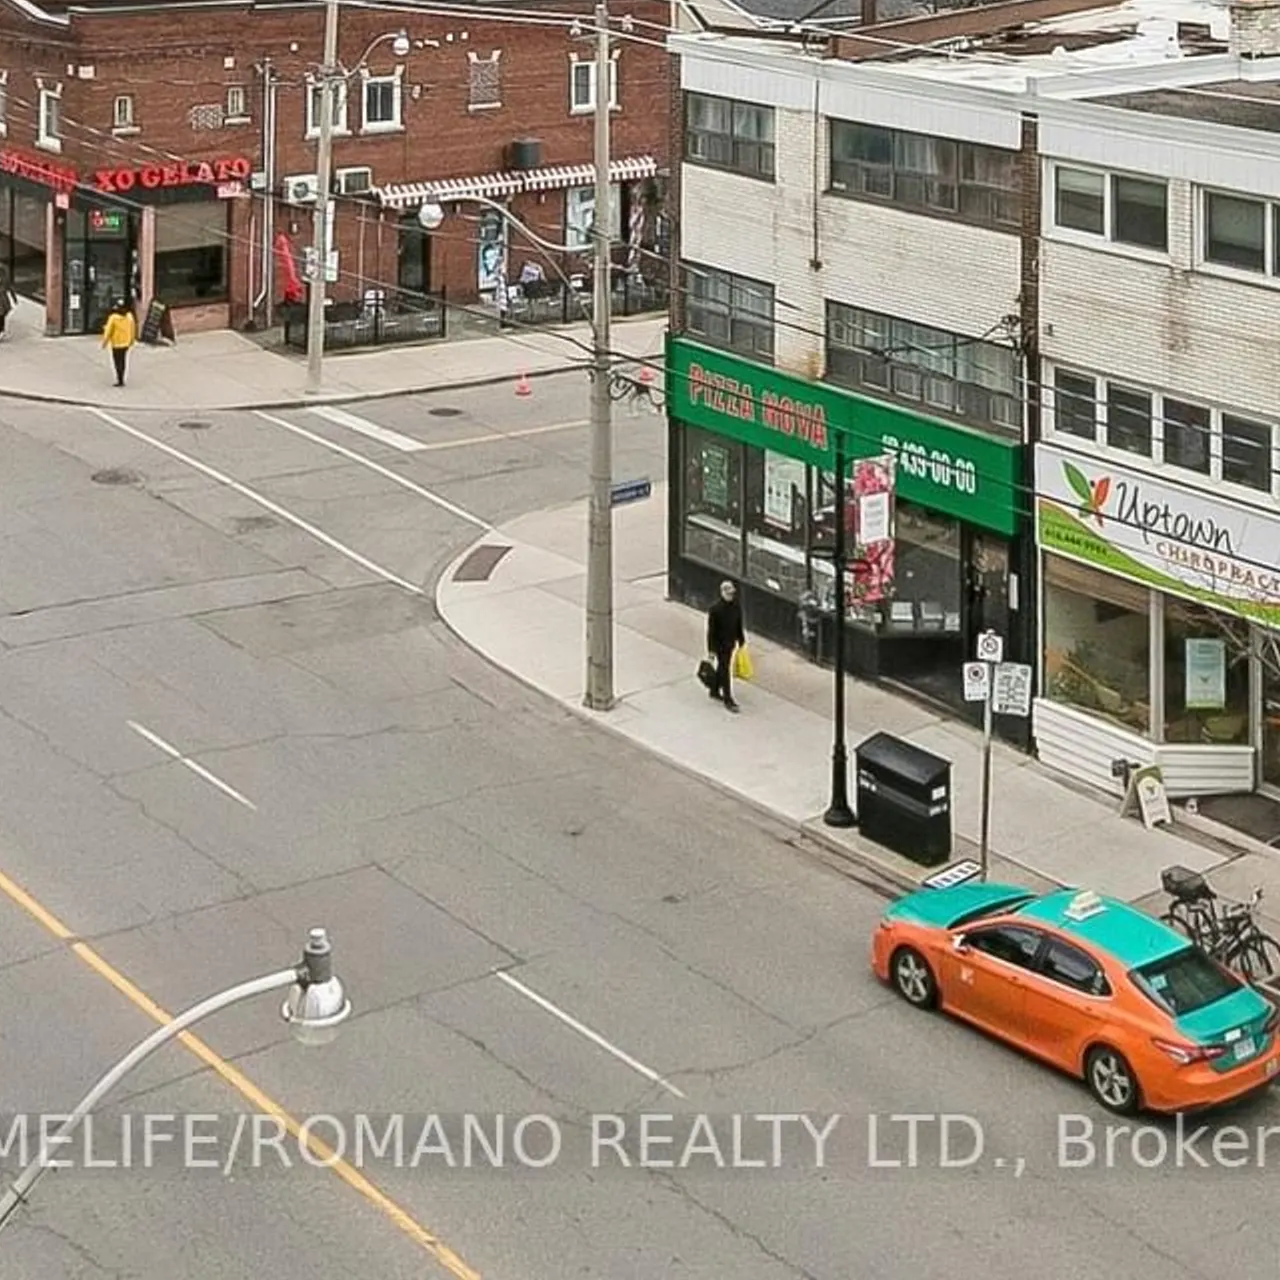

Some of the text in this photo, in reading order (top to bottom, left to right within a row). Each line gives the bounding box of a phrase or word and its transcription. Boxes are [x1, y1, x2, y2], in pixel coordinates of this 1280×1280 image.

[94, 168, 135, 192] XO
[140, 157, 252, 188] GELATO
[688, 363, 755, 421] PIZZA
[761, 389, 829, 451] NOVA
[1115, 481, 1234, 555] Uptown
